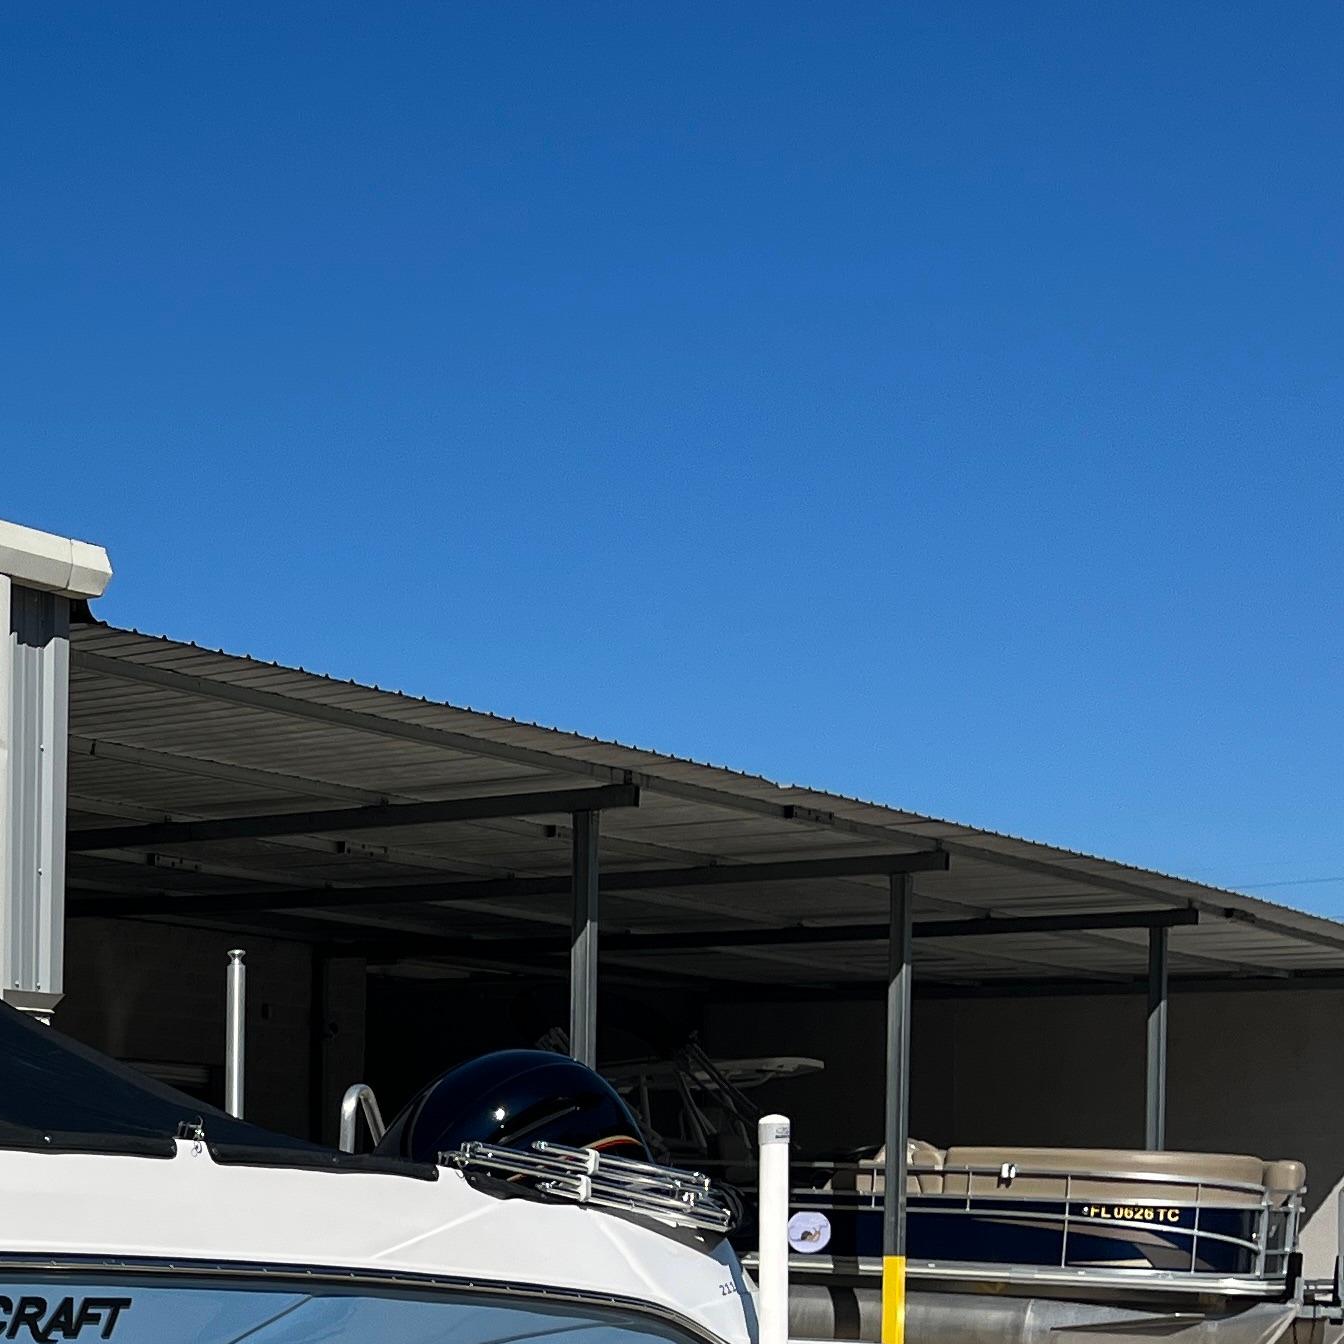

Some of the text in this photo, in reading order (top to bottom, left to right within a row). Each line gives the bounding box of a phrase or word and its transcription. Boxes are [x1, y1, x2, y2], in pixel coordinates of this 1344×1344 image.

[1090, 1206, 1180, 1222] FL 0626 TC
